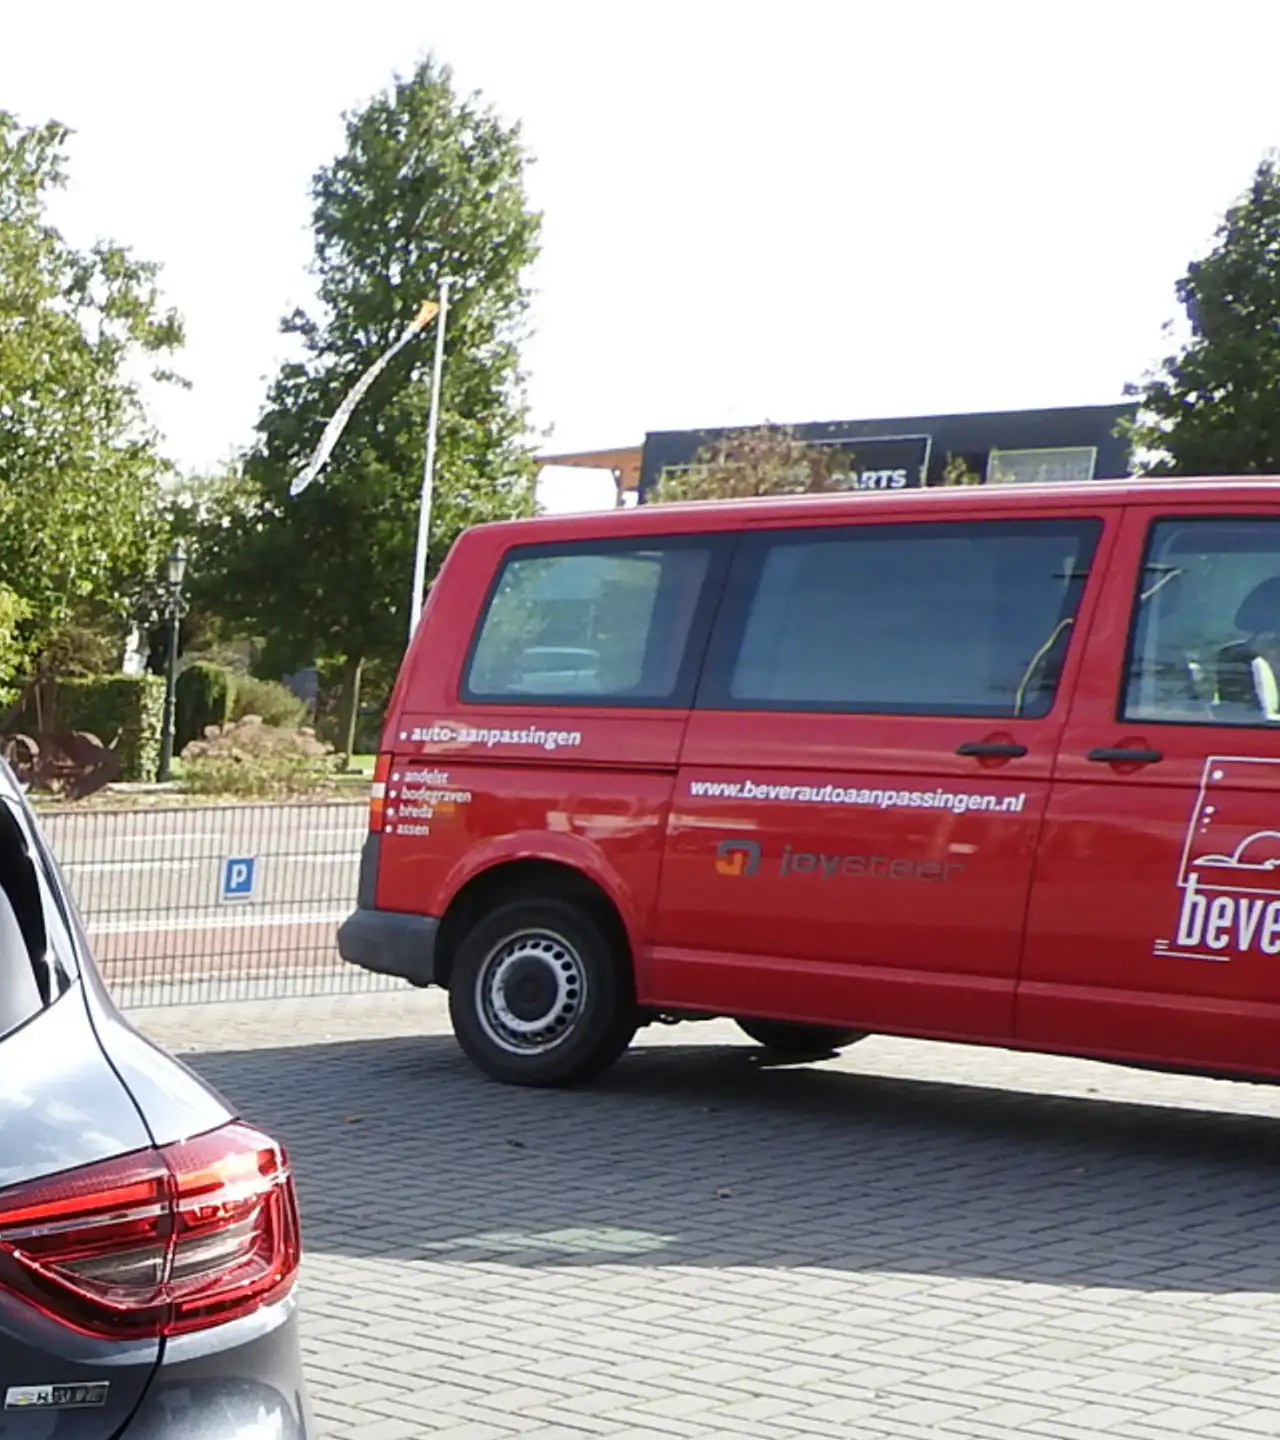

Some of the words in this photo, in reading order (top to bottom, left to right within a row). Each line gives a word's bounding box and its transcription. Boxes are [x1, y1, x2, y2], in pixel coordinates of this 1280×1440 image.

[411, 725, 582, 750] auto-aanpassingen
[690, 780, 1026, 813] www.beverautoaanpassingen.nl
[230, 862, 247, 889] P
